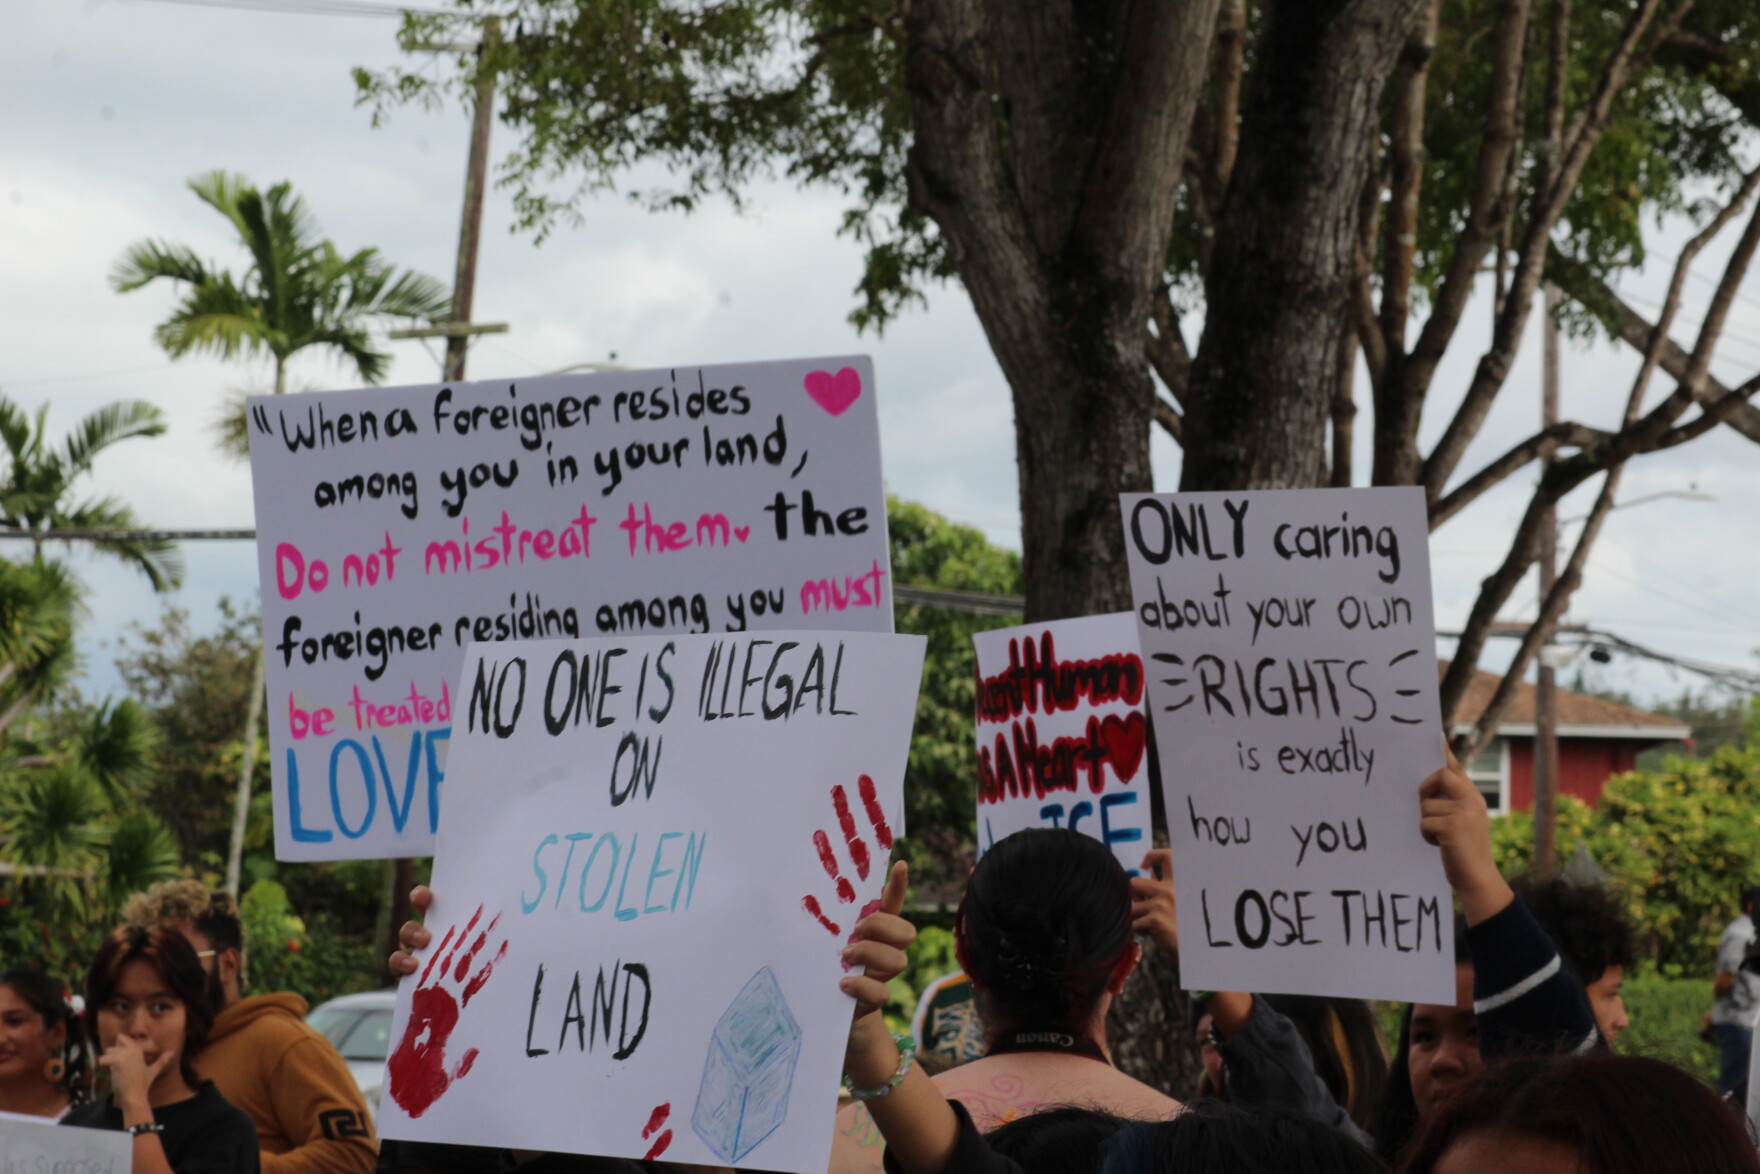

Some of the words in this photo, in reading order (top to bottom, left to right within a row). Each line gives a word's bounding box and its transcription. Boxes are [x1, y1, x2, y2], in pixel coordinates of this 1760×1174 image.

[433, 383, 600, 451] foreigner
[614, 368, 750, 423] resides
[314, 471, 418, 520] among
[440, 459, 518, 518] you
[546, 441, 578, 487] in
[594, 438, 689, 496] your
[703, 414, 808, 479] land,
[275, 542, 329, 600] Do
[343, 530, 402, 588] not
[425, 502, 598, 575] mistreat
[764, 489, 869, 541] the
[1131, 498, 1250, 565] ONLY
[1273, 511, 1401, 584] caring
[276, 610, 442, 681] foreigner
[455, 592, 580, 646] residing
[595, 593, 710, 635] among
[726, 587, 784, 632] you
[801, 558, 887, 615] must
[1141, 573, 1232, 632] about
[1246, 596, 1317, 646] your
[1338, 596, 1412, 630] own
[288, 690, 335, 740] be
[347, 678, 450, 731] treated
[469, 656, 527, 739] NO
[543, 648, 628, 736] ONE
[636, 641, 675, 723] IS
[699, 639, 858, 722] ILLEGAL
[1022, 630, 1145, 716] Human
[1193, 654, 1378, 722] RIGHTS
[610, 731, 663, 807] ON
[1012, 714, 1108, 800] Heart
[1238, 741, 1261, 772] is
[1278, 726, 1375, 786] exactly
[1188, 795, 1251, 846] how
[1291, 817, 1368, 868] you
[521, 831, 707, 921] STOLEN
[1202, 889, 1322, 950] LOSE
[1330, 890, 1442, 952] THEM
[526, 958, 652, 1060] LAND
[1016, 1031, 1075, 1048] Canon
